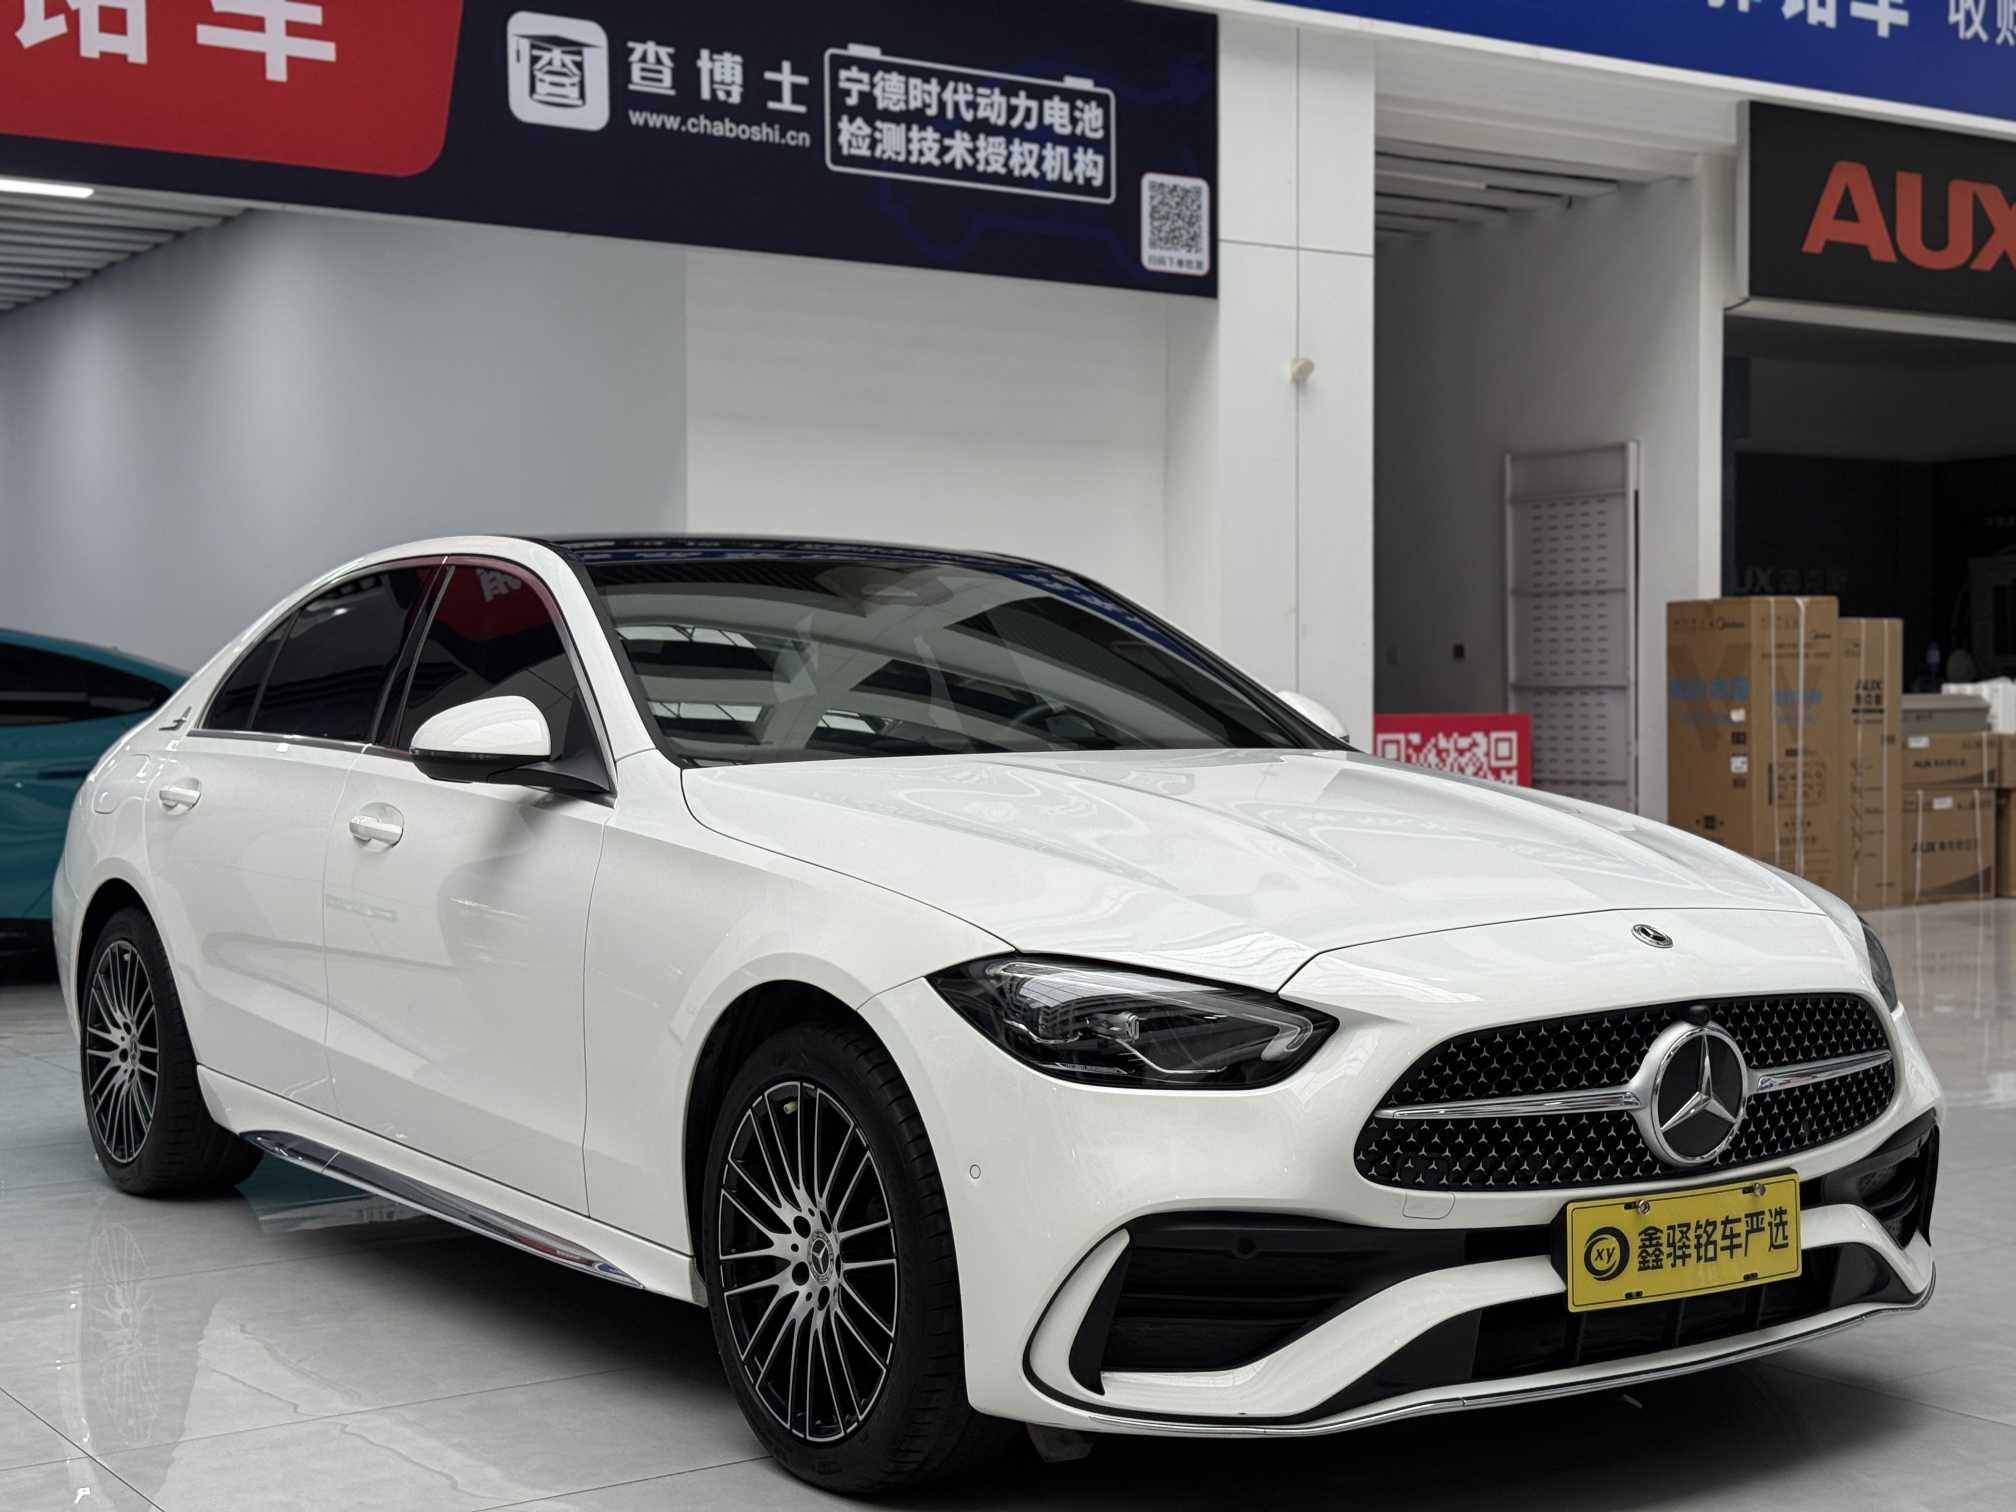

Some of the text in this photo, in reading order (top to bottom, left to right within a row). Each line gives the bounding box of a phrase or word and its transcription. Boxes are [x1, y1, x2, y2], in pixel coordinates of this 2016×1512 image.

[627, 40, 809, 114] 查博士
[838, 66, 1105, 139] 宁德时代动力电池
[628, 108, 811, 147] www.chaboshi.cn
[837, 114, 1105, 187] 检测技术授权机构
[1801, 160, 2016, 272] AUX
[1637, 1206, 1790, 1272] 鑫驿铭车严选
